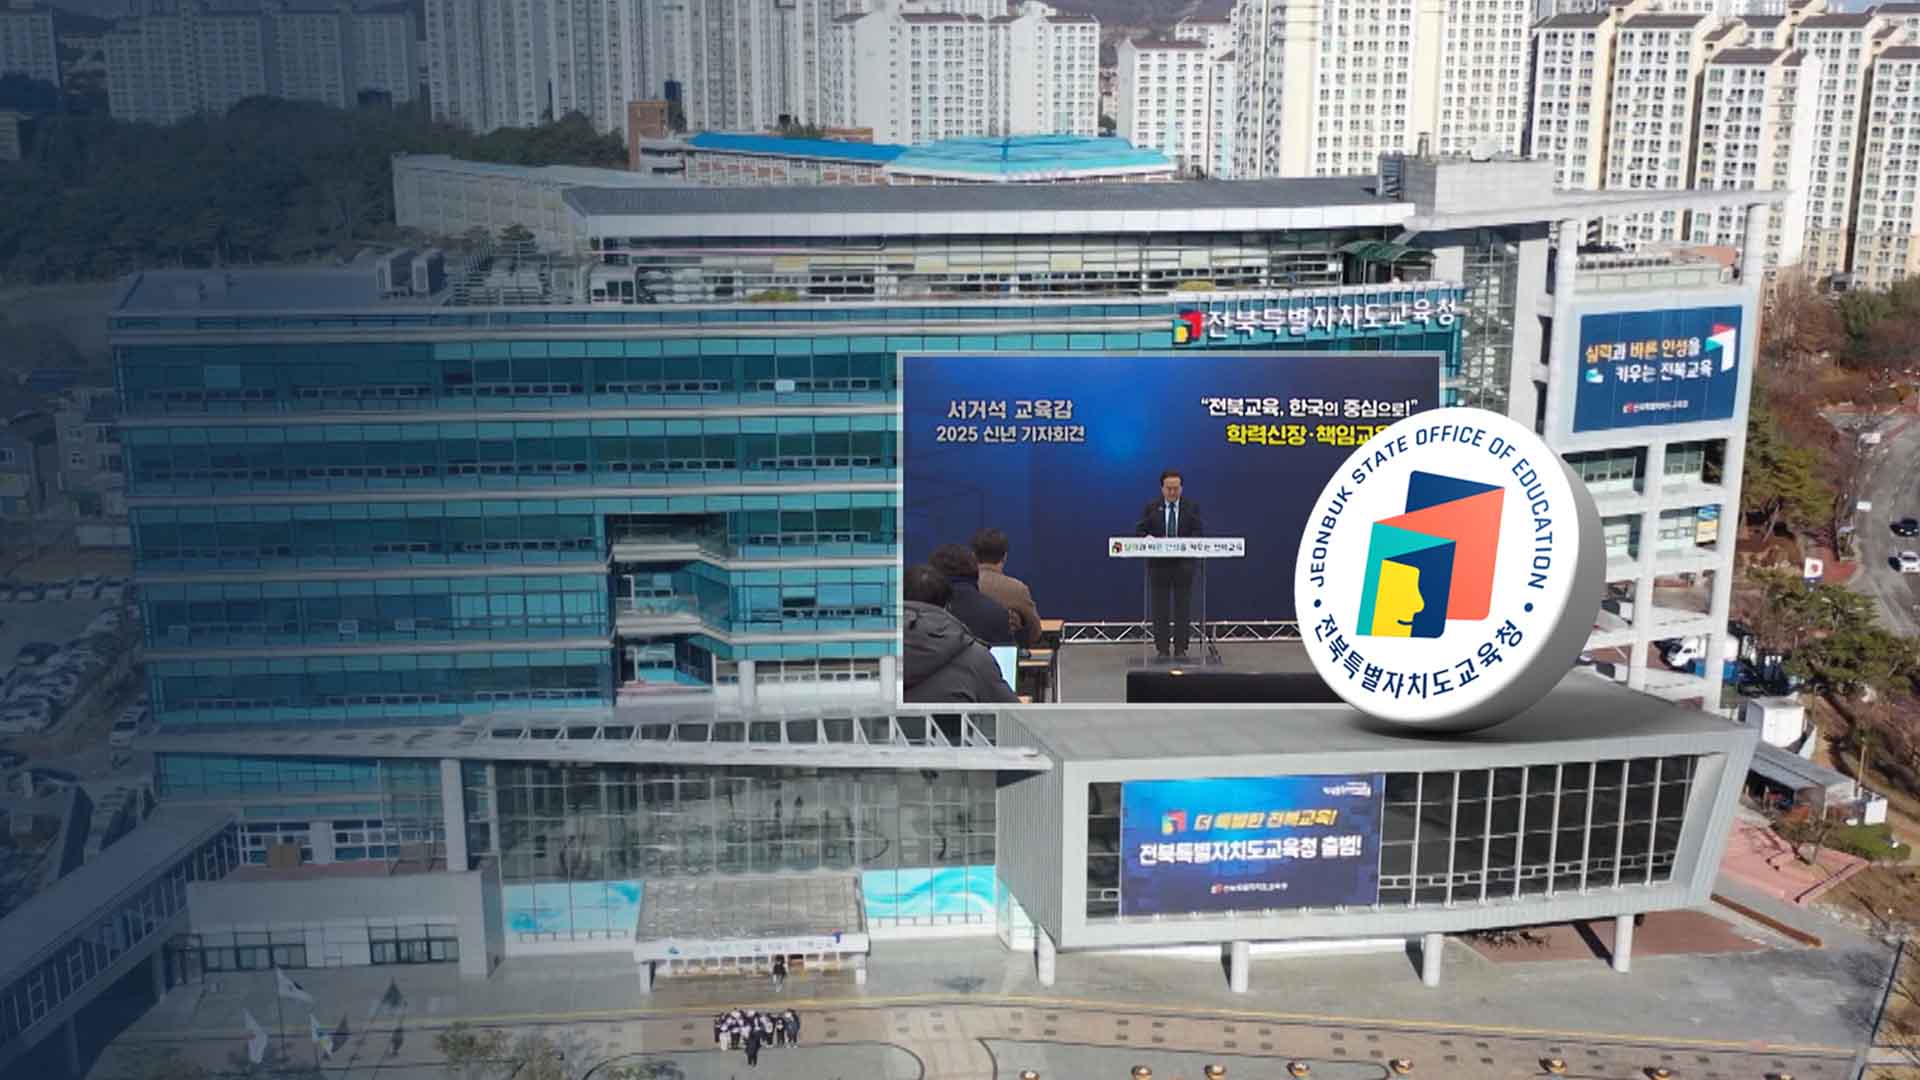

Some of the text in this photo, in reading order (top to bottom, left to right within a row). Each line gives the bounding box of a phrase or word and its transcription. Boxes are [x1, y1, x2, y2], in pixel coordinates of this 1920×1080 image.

[1208, 298, 1457, 337] 전북특별자치도교육청
[1585, 337, 1701, 363] 실력과 바른 인성을
[1615, 359, 1713, 383] 키우는 전북교육
[948, 400, 1073, 419] 서거석 교육감
[1289, 397, 1338, 417] 한국의
[936, 426, 1085, 442] 2025 신년 기자회견
[1226, 424, 1388, 445] 학력신장·책임교
[1139, 835, 1363, 865] 전북특별자치도교육청 출범!
